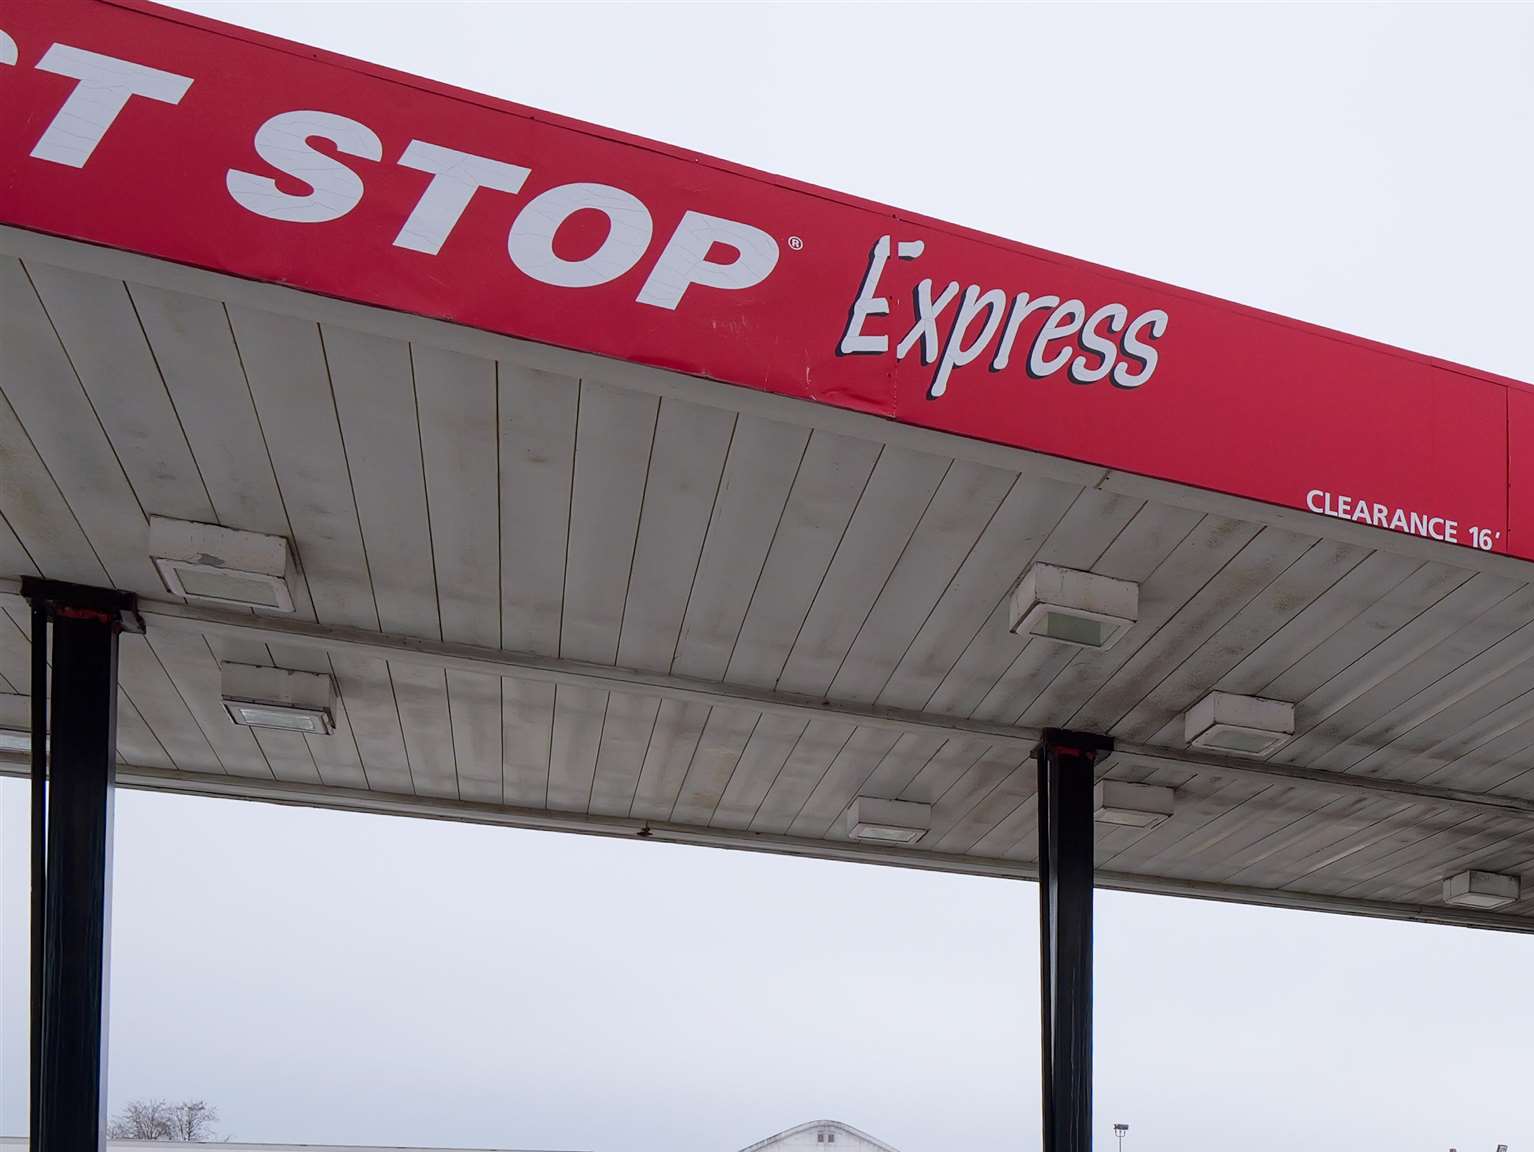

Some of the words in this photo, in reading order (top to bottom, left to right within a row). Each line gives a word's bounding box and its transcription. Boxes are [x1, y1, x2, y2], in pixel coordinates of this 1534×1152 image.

[0, 29, 195, 168] T
[838, 234, 1169, 399] Express
[1306, 489, 1458, 544] CLEARANCE
[1468, 526, 1501, 551] 16'
